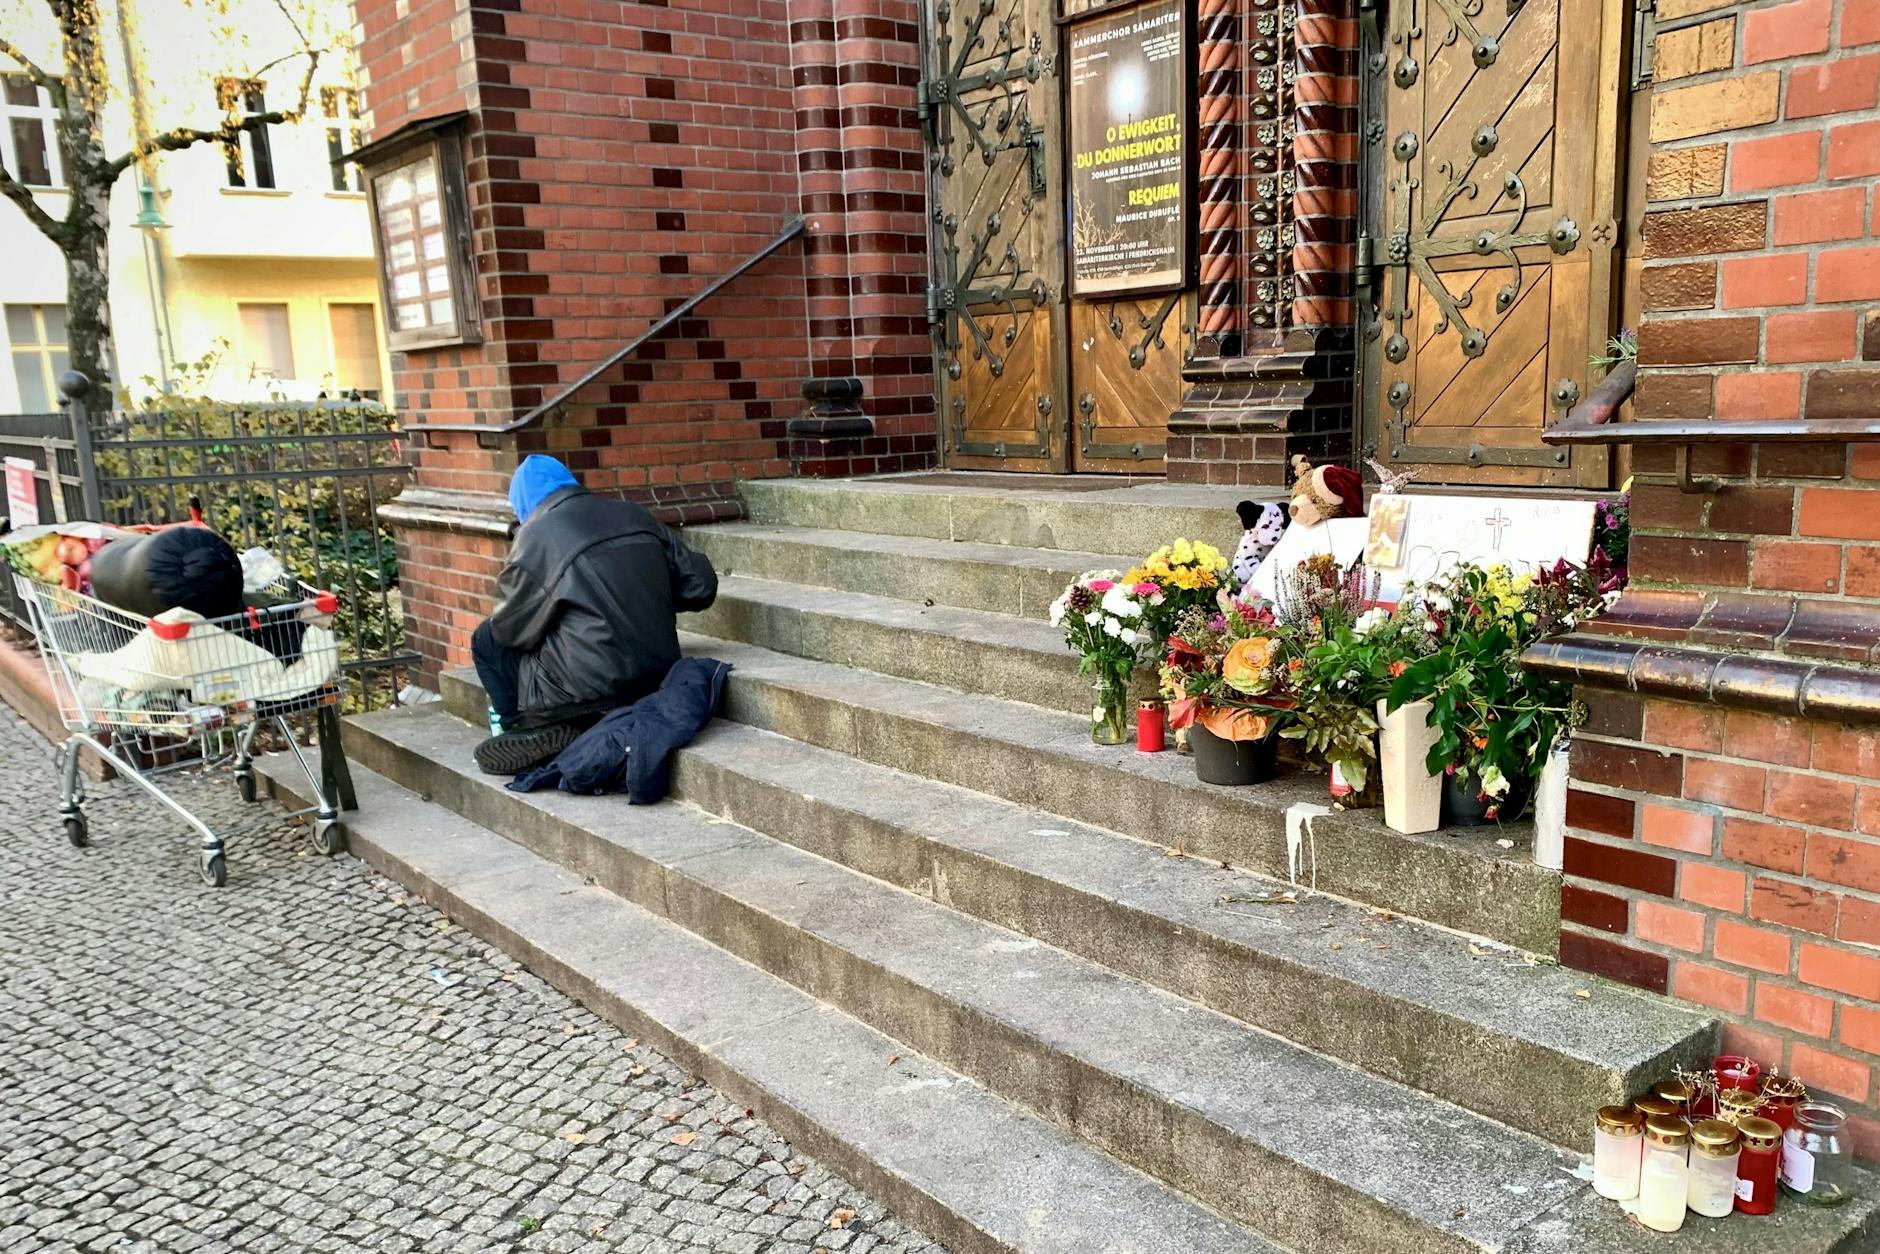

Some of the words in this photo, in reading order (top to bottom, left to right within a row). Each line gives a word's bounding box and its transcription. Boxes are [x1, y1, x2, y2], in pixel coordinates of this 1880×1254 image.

[1073, 27, 1130, 48] KAMMERCHOR
[1133, 12, 1180, 33] SAMARITER
[1106, 126, 1116, 143] O
[1119, 113, 1180, 140] EWIGKEIT,
[1076, 151, 1093, 169] DU
[1095, 134, 1181, 165] DONNERWORT
[1091, 167, 1119, 180] JOHANN
[1120, 159, 1159, 175] SEBASTIAN
[1160, 156, 1181, 168] BACH
[1128, 182, 1180, 206] REQUIEM
[1115, 211, 1147, 223] MAURICE
[1076, 251, 1125, 265] SAMARITERKIRCHE
[1128, 246, 1175, 259] FRIEDRICHSHAIN
[1086, 244, 1115, 255] NOVEMBER
[1120, 241, 1137, 251] 20:00
[1137, 240, 1149, 248] UHR
